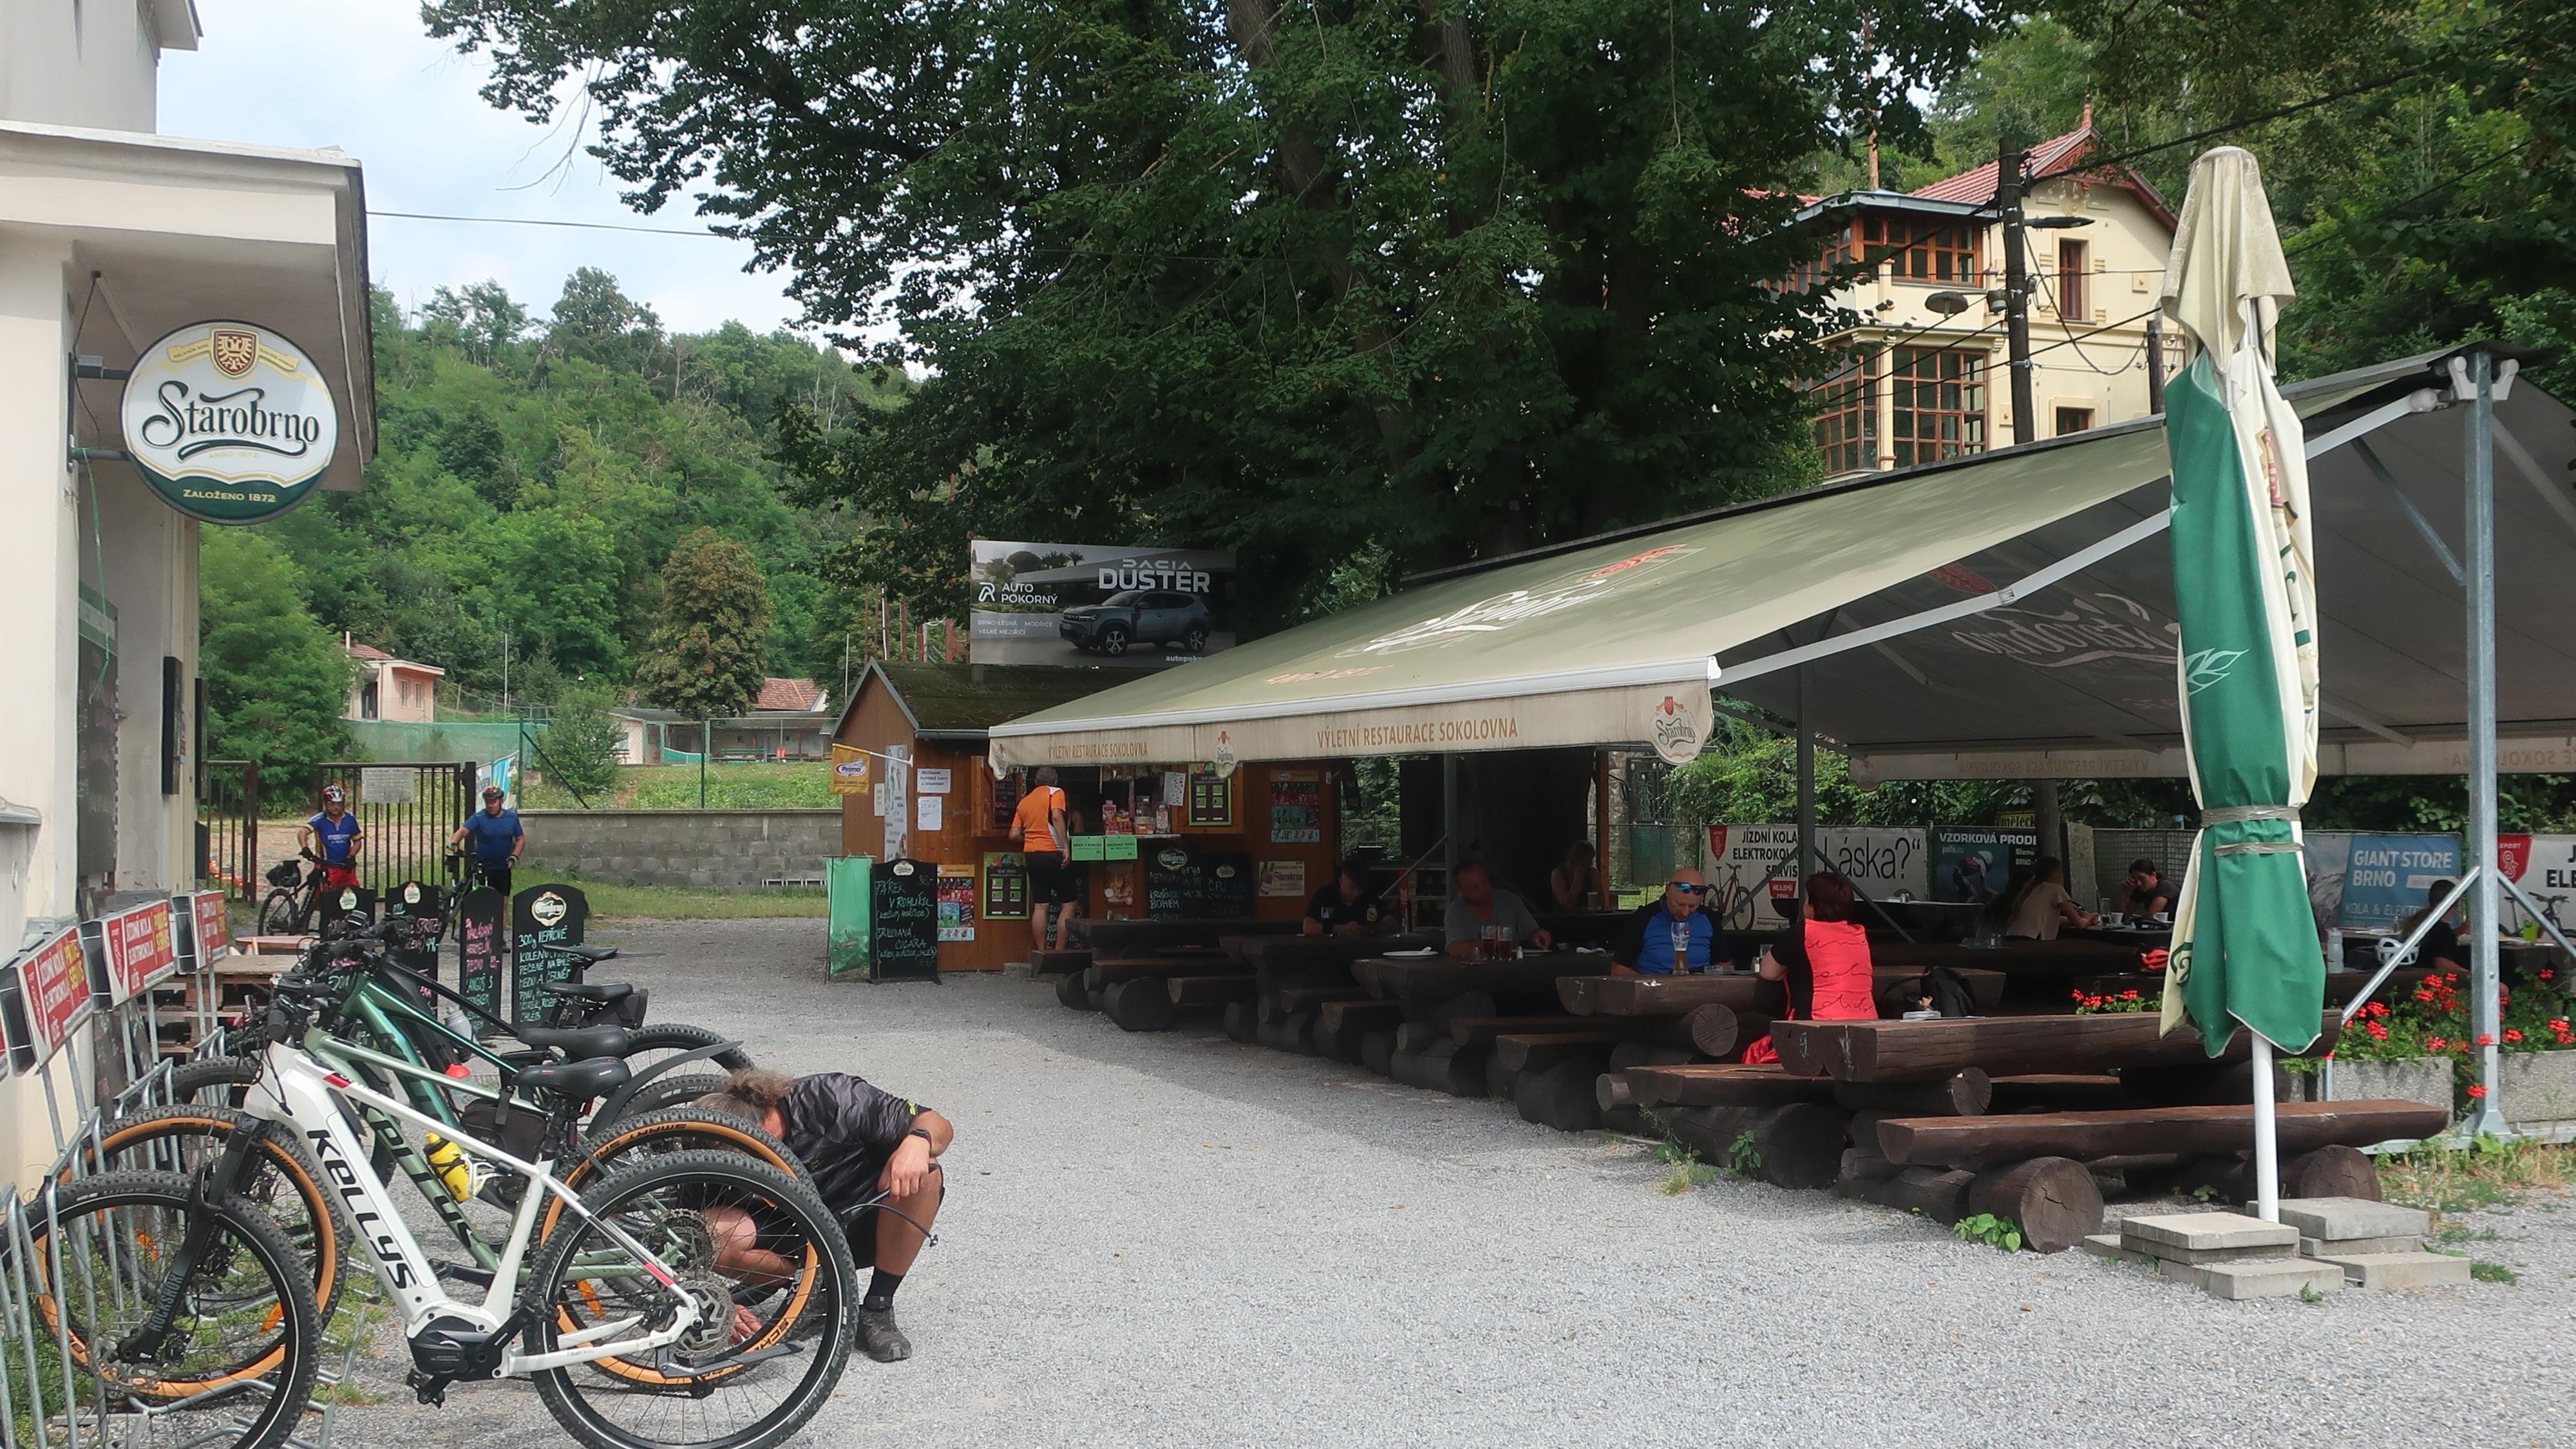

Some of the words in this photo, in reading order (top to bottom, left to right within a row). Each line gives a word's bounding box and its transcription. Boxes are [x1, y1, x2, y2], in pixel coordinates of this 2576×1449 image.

[142, 380, 320, 454] Starobrno
[183, 489, 245, 500] ZALOŽENO
[249, 493, 276, 502] 1872
[1123, 559, 1193, 570] DACIA
[1001, 583, 1034, 592] AUTO
[1099, 568, 1211, 593] DUSTER
[1001, 594, 1058, 604] POKORNÝ
[1317, 723, 1360, 748] VÝLETNÍ
[1363, 723, 1435, 746] RESTAURACE
[1439, 717, 1518, 741] SOKOLOVNA
[1655, 718, 1696, 746] Starobrno
[1048, 742, 1072, 759] VÝLETNÍ
[1072, 743, 1108, 759] RESTAURACE
[1110, 742, 1149, 757] SOKOLOVNA
[1742, 828, 1770, 844] JÍZDNÍ
[1772, 831, 1798, 844] KOLA
[1939, 832, 1997, 844] VZORKOVÁ
[2354, 850, 2400, 867] GIANT
[2401, 851, 2453, 868] STORE
[2353, 869, 2396, 887] BRNO
[307, 1129, 419, 1290] KELLYS
